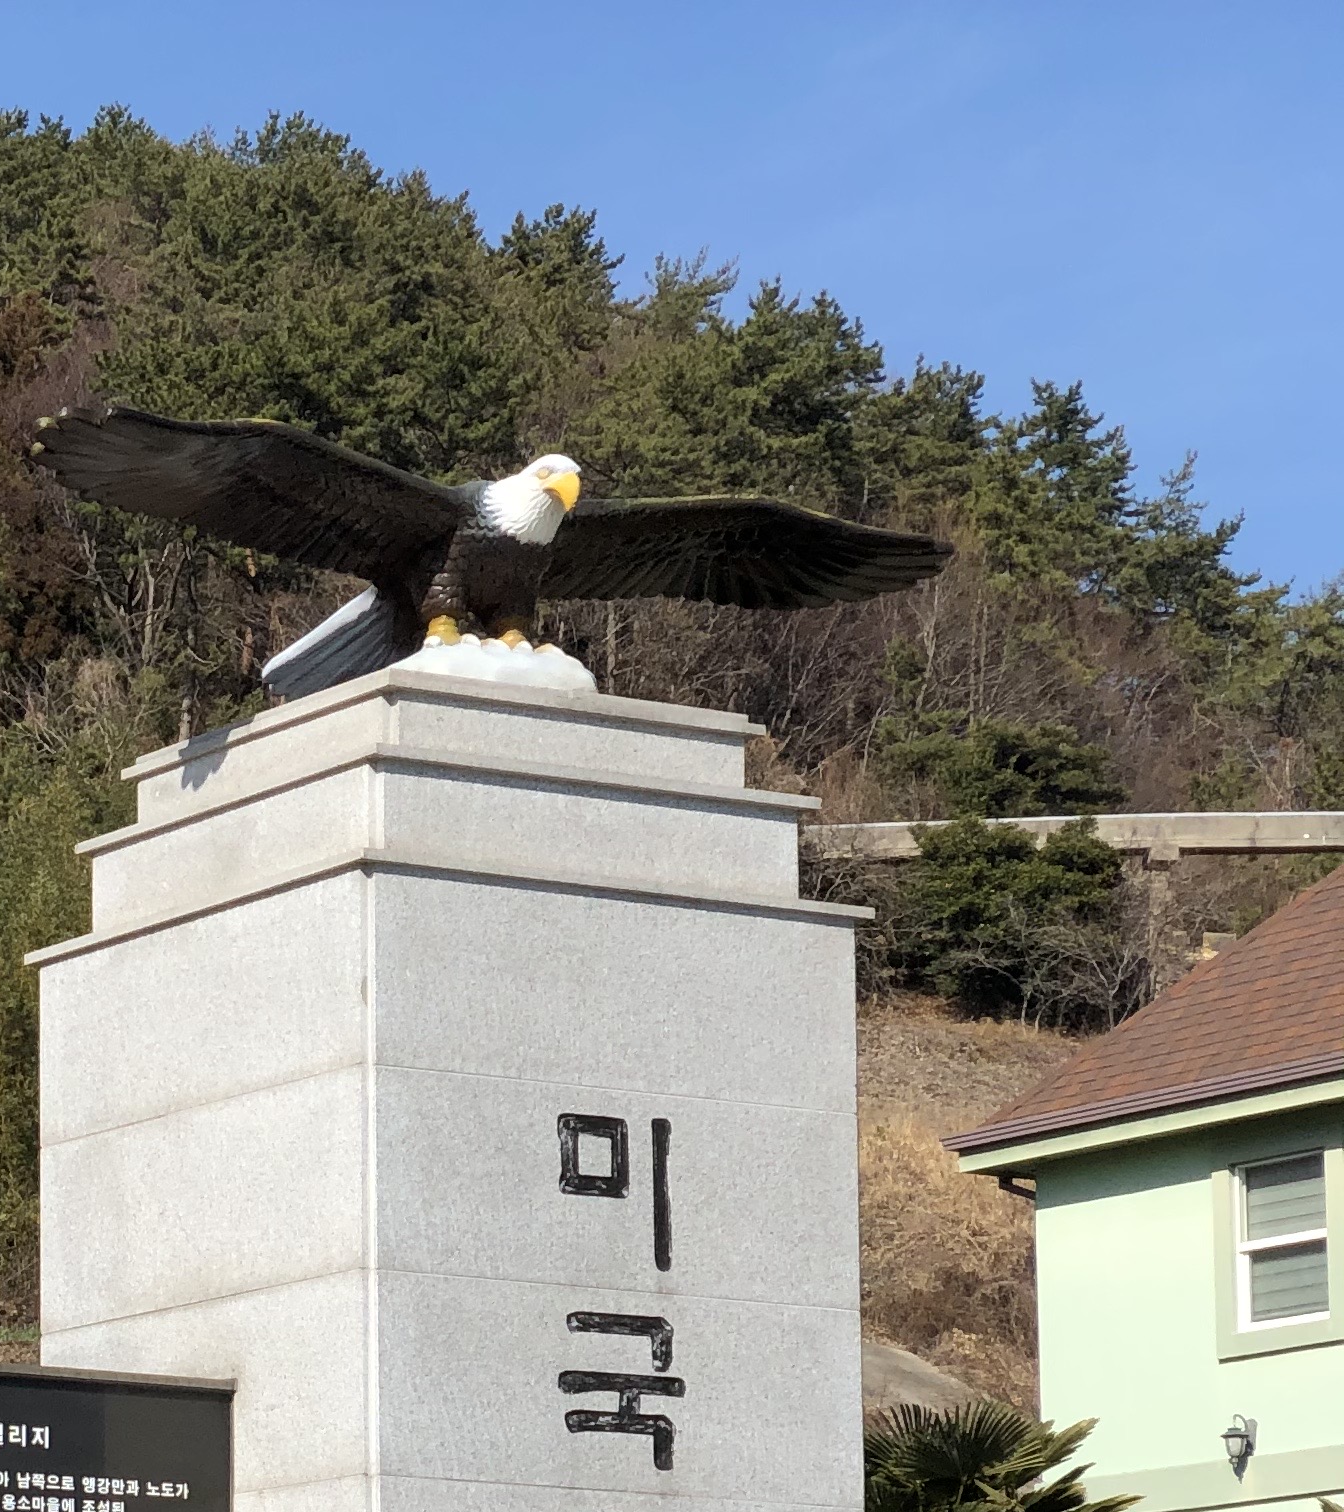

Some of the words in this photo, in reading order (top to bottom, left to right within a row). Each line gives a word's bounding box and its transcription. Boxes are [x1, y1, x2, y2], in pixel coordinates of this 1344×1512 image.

[16, 1472, 75, 1491] 남쪽으로
[81, 1476, 140, 1497] 앵강만과
[145, 1481, 190, 1500] 노도가
